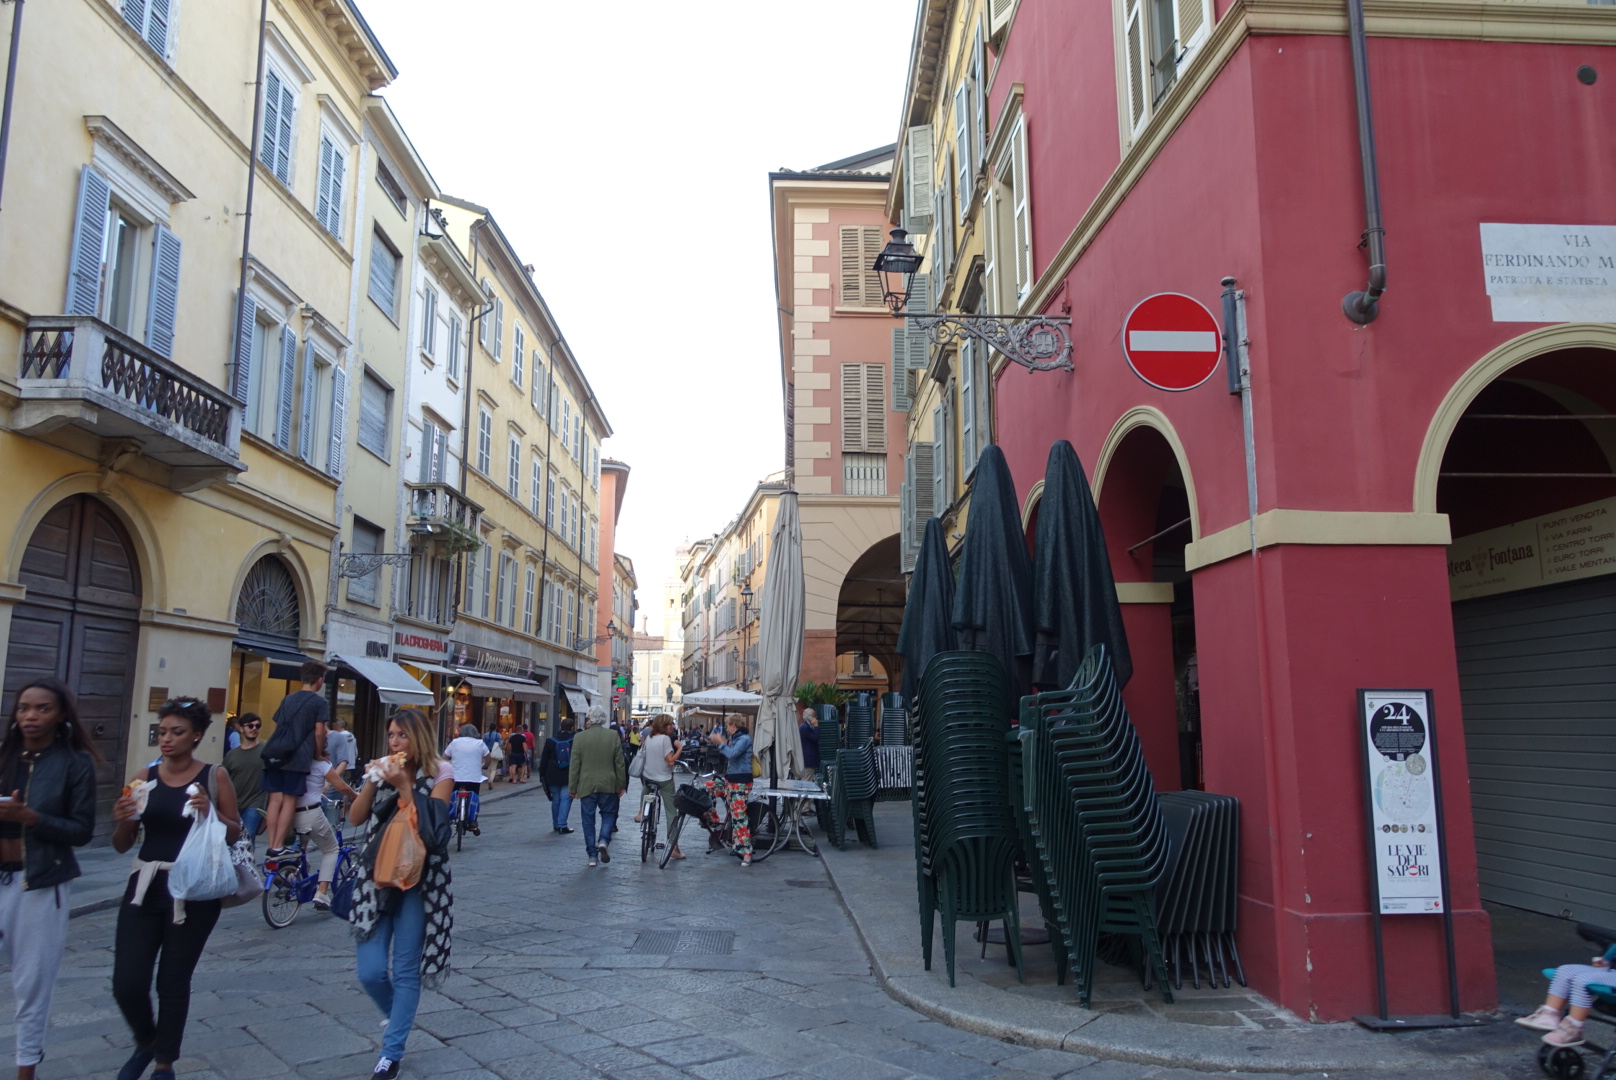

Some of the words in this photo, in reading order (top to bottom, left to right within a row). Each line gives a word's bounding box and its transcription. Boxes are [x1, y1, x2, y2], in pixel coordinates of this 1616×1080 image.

[1563, 234, 1591, 248] VIA
[1485, 253, 1590, 268] FERDINANDO
[1490, 275, 1542, 285] PATRIOTA
[1546, 276, 1554, 285] E
[1557, 276, 1609, 286] STATISTA
[1543, 517, 1567, 530] PUNTI
[1569, 507, 1608, 523] VENDITA
[1552, 532, 1565, 541] VIA
[1566, 525, 1593, 537] FARINI
[1552, 539, 1586, 552] CENTRO
[1589, 532, 1615, 544] TORRI
[1488, 544, 1534, 571] Fontana
[1553, 552, 1576, 563] EURO
[1578, 546, 1605, 558] TORRI
[1554, 563, 1577, 574] VIALE
[1579, 556, 1616, 569] MENTAN
[1383, 704, 1411, 725] 24
[1388, 844, 1404, 856] LE
[1405, 844, 1427, 856] VIE
[1397, 855, 1418, 866] DEI
[1387, 865, 1429, 877] SAPORI
